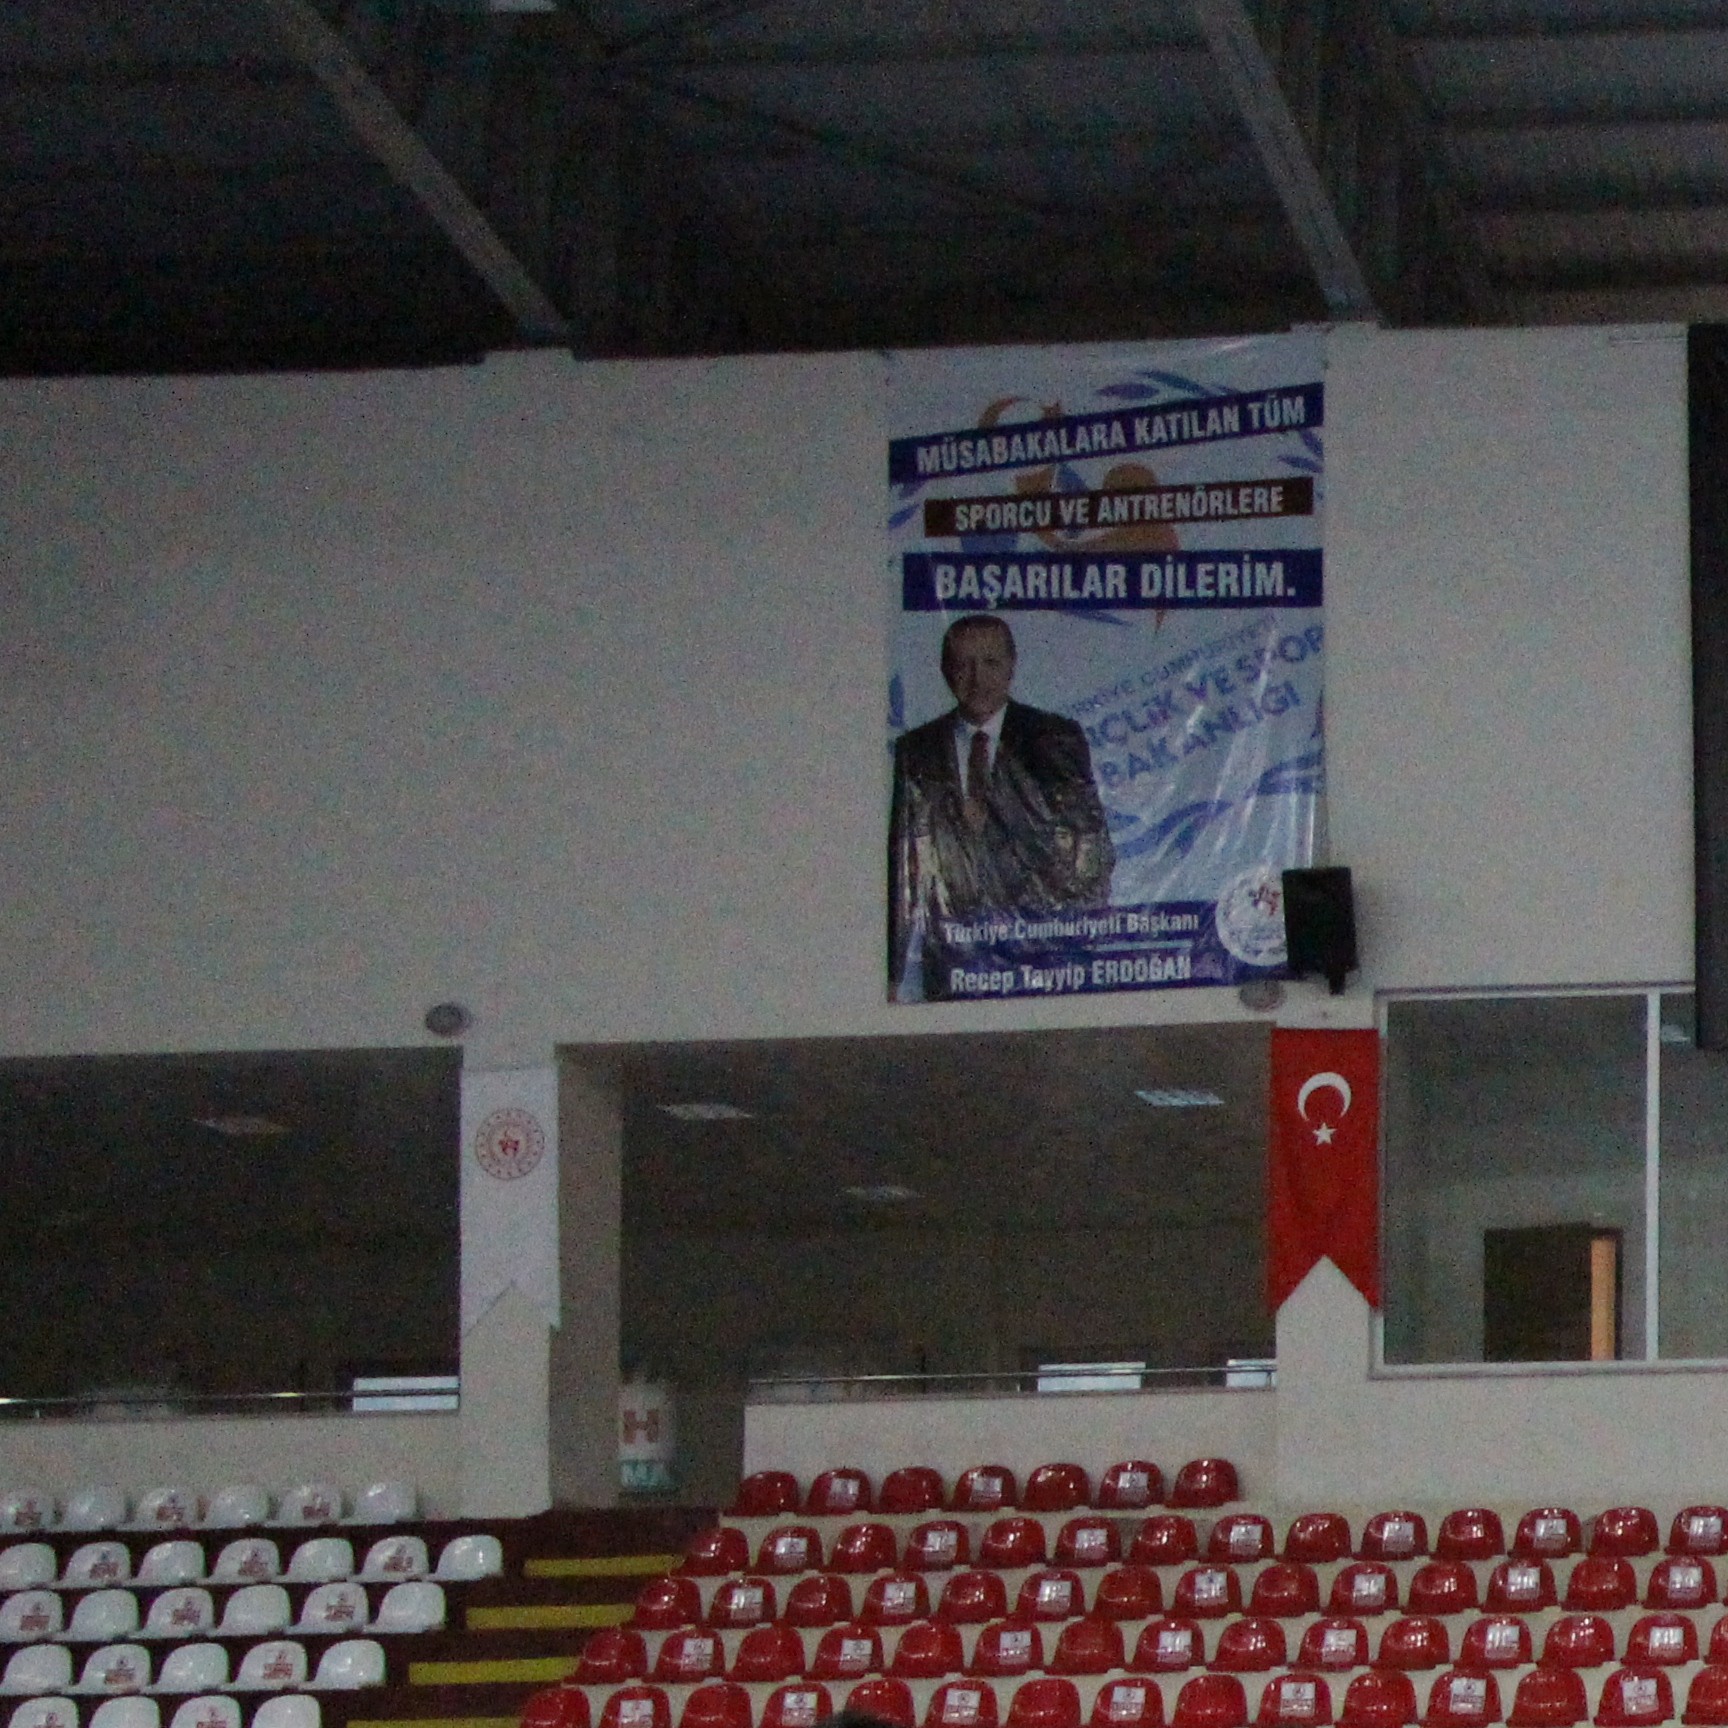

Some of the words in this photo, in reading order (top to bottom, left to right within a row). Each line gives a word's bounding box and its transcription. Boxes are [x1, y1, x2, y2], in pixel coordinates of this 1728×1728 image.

[916, 421, 1127, 475] MÜSABAKALARA
[1134, 402, 1240, 445] KATILAN
[1247, 395, 1305, 429] TÜM
[955, 500, 1051, 532] SPORCU
[1060, 498, 1090, 526] VE
[1097, 484, 1284, 523] ANTRENÖRLERE
[935, 563, 1129, 609] BAŞARILAR
[1141, 554, 1297, 598] DİLERİM.
[1125, 912, 1200, 938] Başkanı
[950, 967, 1016, 994] Recep
[1020, 961, 1086, 992] Tayyip
[1091, 951, 1192, 984] ERDOĞAN
